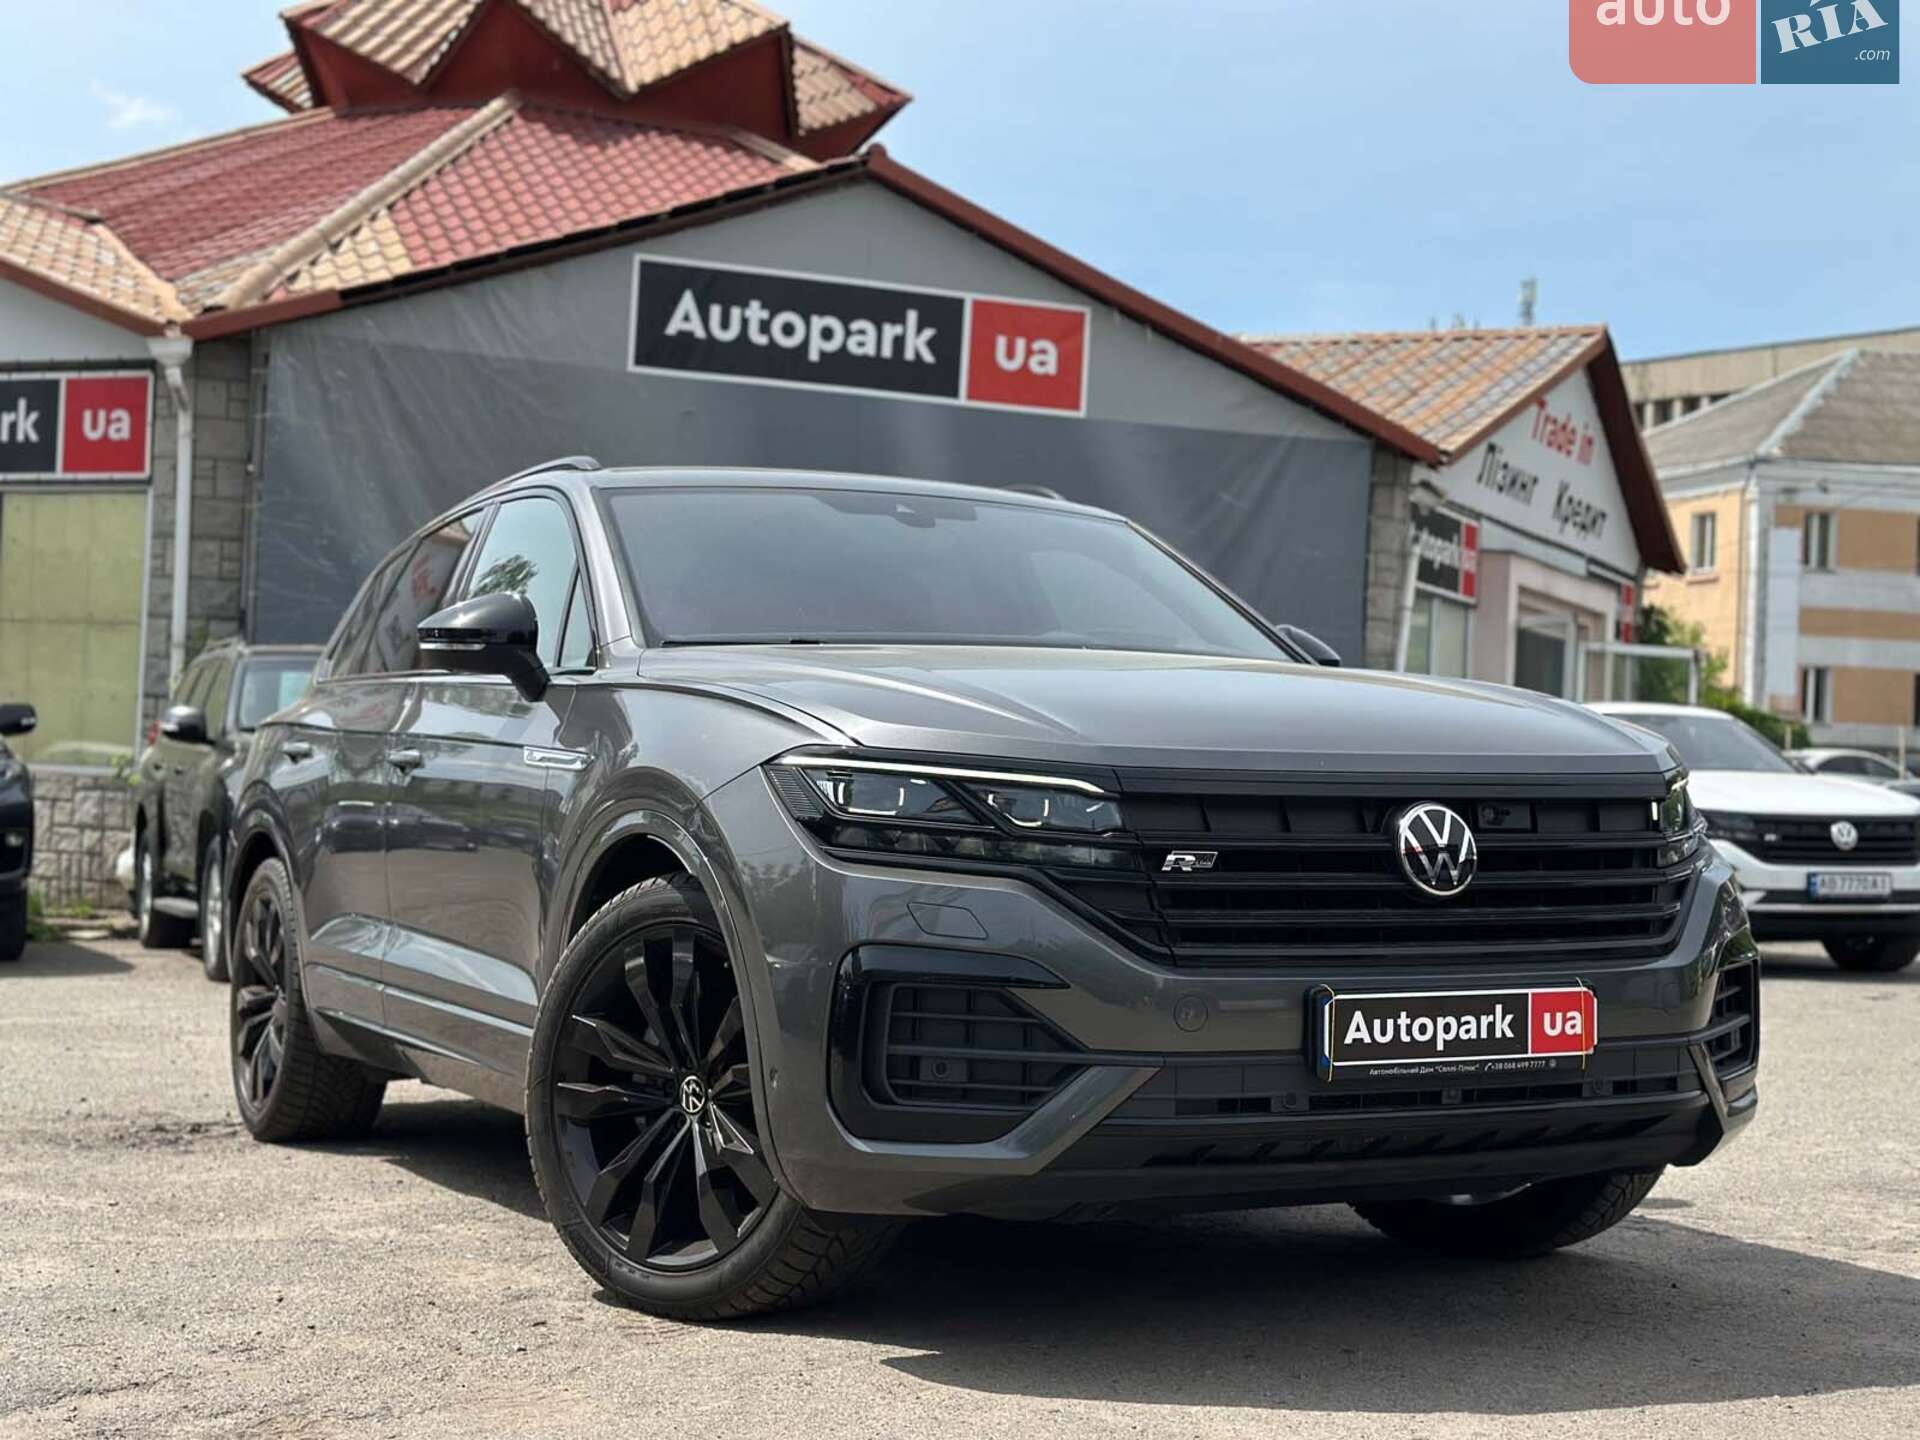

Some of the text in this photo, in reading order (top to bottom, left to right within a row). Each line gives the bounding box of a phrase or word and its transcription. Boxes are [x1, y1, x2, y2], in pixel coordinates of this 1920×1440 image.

[664, 289, 1059, 376] Autopark ua
[82, 407, 132, 441] ua
[1531, 398, 1595, 467] Trade in
[1551, 479, 1608, 541] Кредит
[1343, 1003, 1583, 1051] Autopark ua
